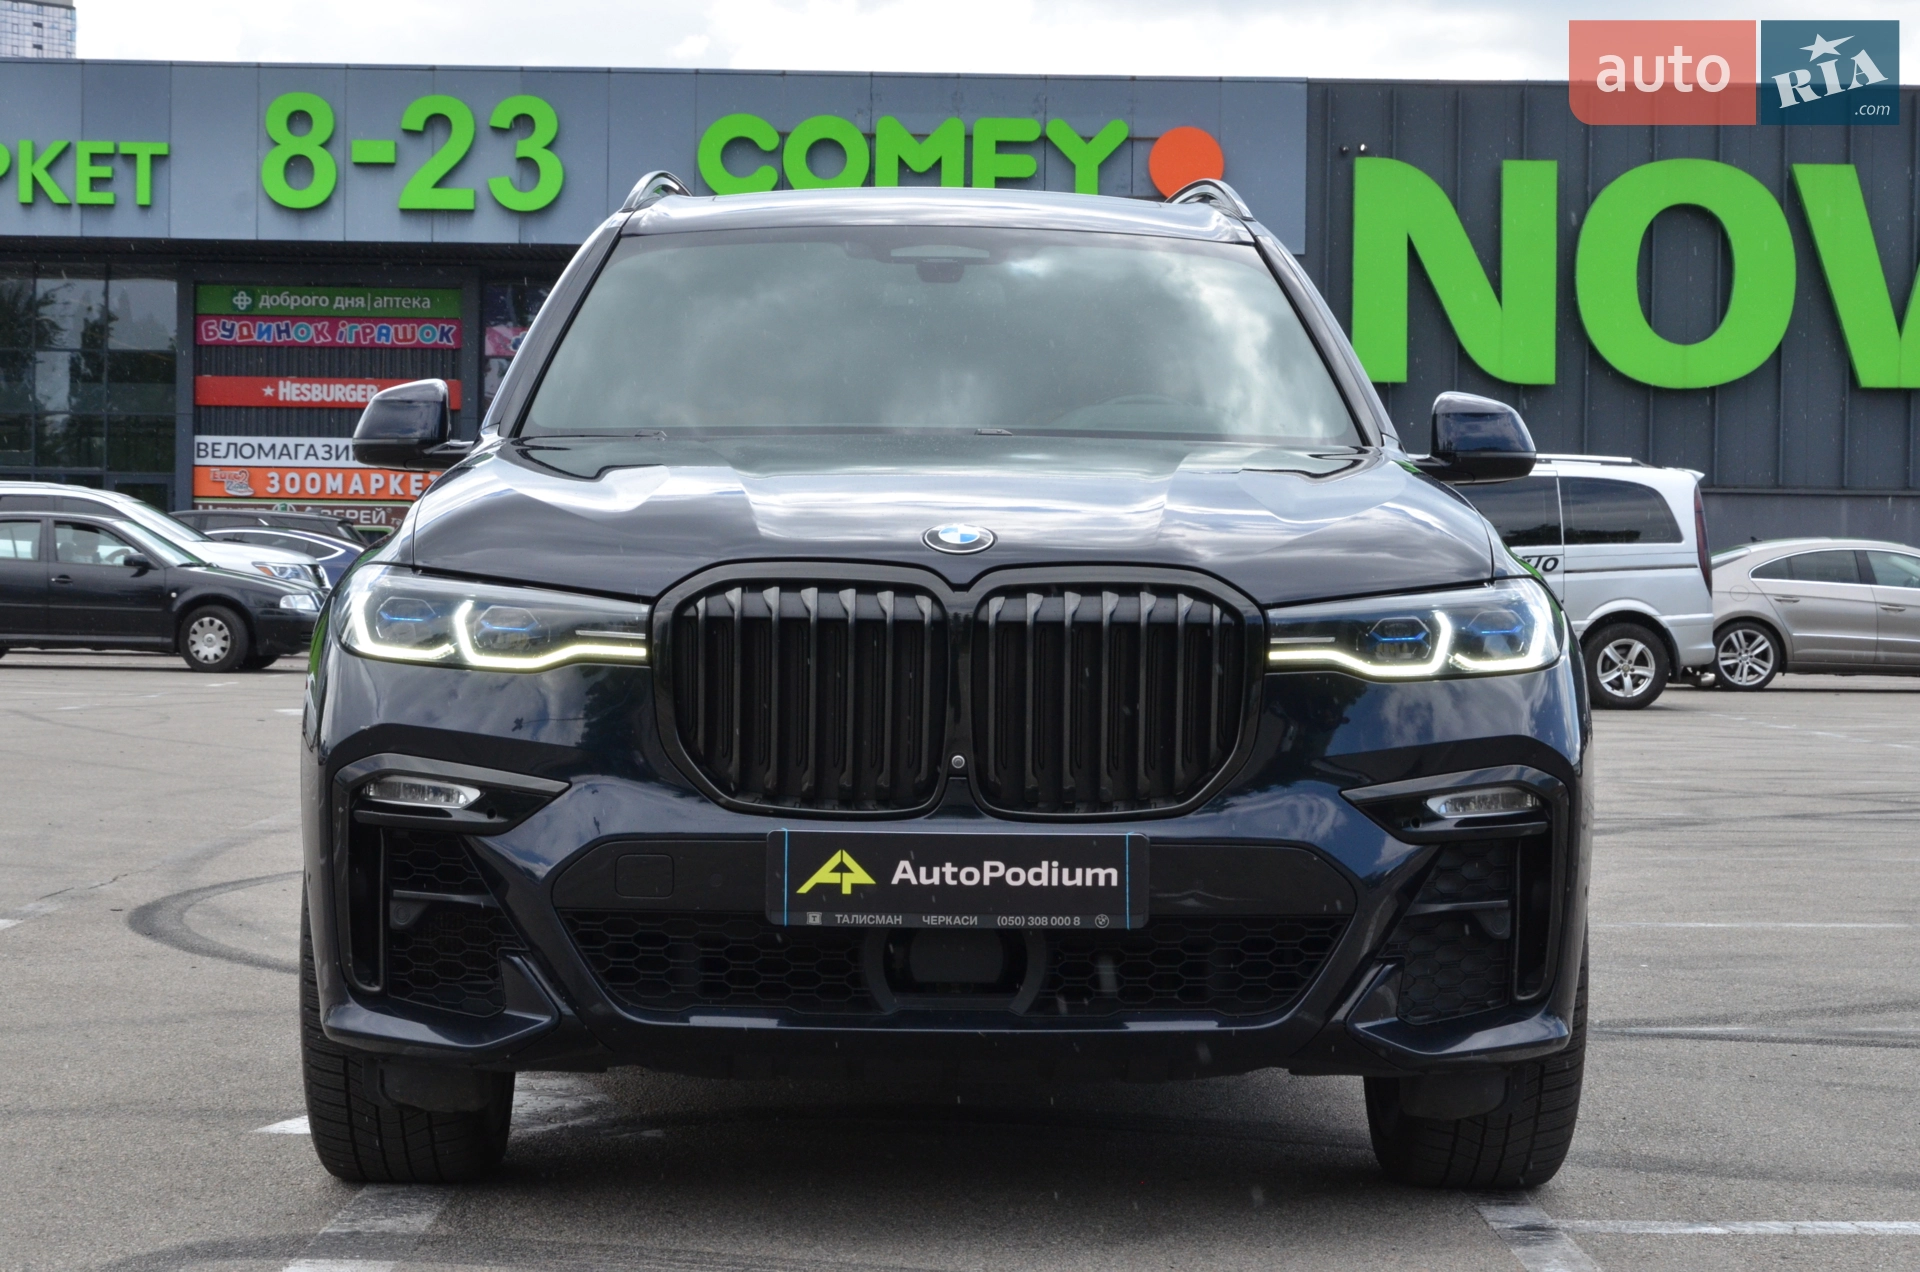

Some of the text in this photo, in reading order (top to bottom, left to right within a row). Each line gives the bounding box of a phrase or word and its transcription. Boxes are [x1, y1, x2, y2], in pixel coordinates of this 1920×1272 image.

[261, 92, 563, 212] 8-23
[697, 113, 1129, 196] COMFY
[1352, 157, 1920, 389] NOV
[259, 291, 330, 310] доброго
[373, 298, 431, 310] аптека
[196, 442, 357, 461] ВЕЛОМАГАЗИ
[891, 861, 1118, 887] AutoPodium
[835, 914, 902, 925] ТАЛИСМАН
[922, 915, 978, 925] ЧЕРКАСИ
[997, 916, 1081, 926] (050) 308 000 8
